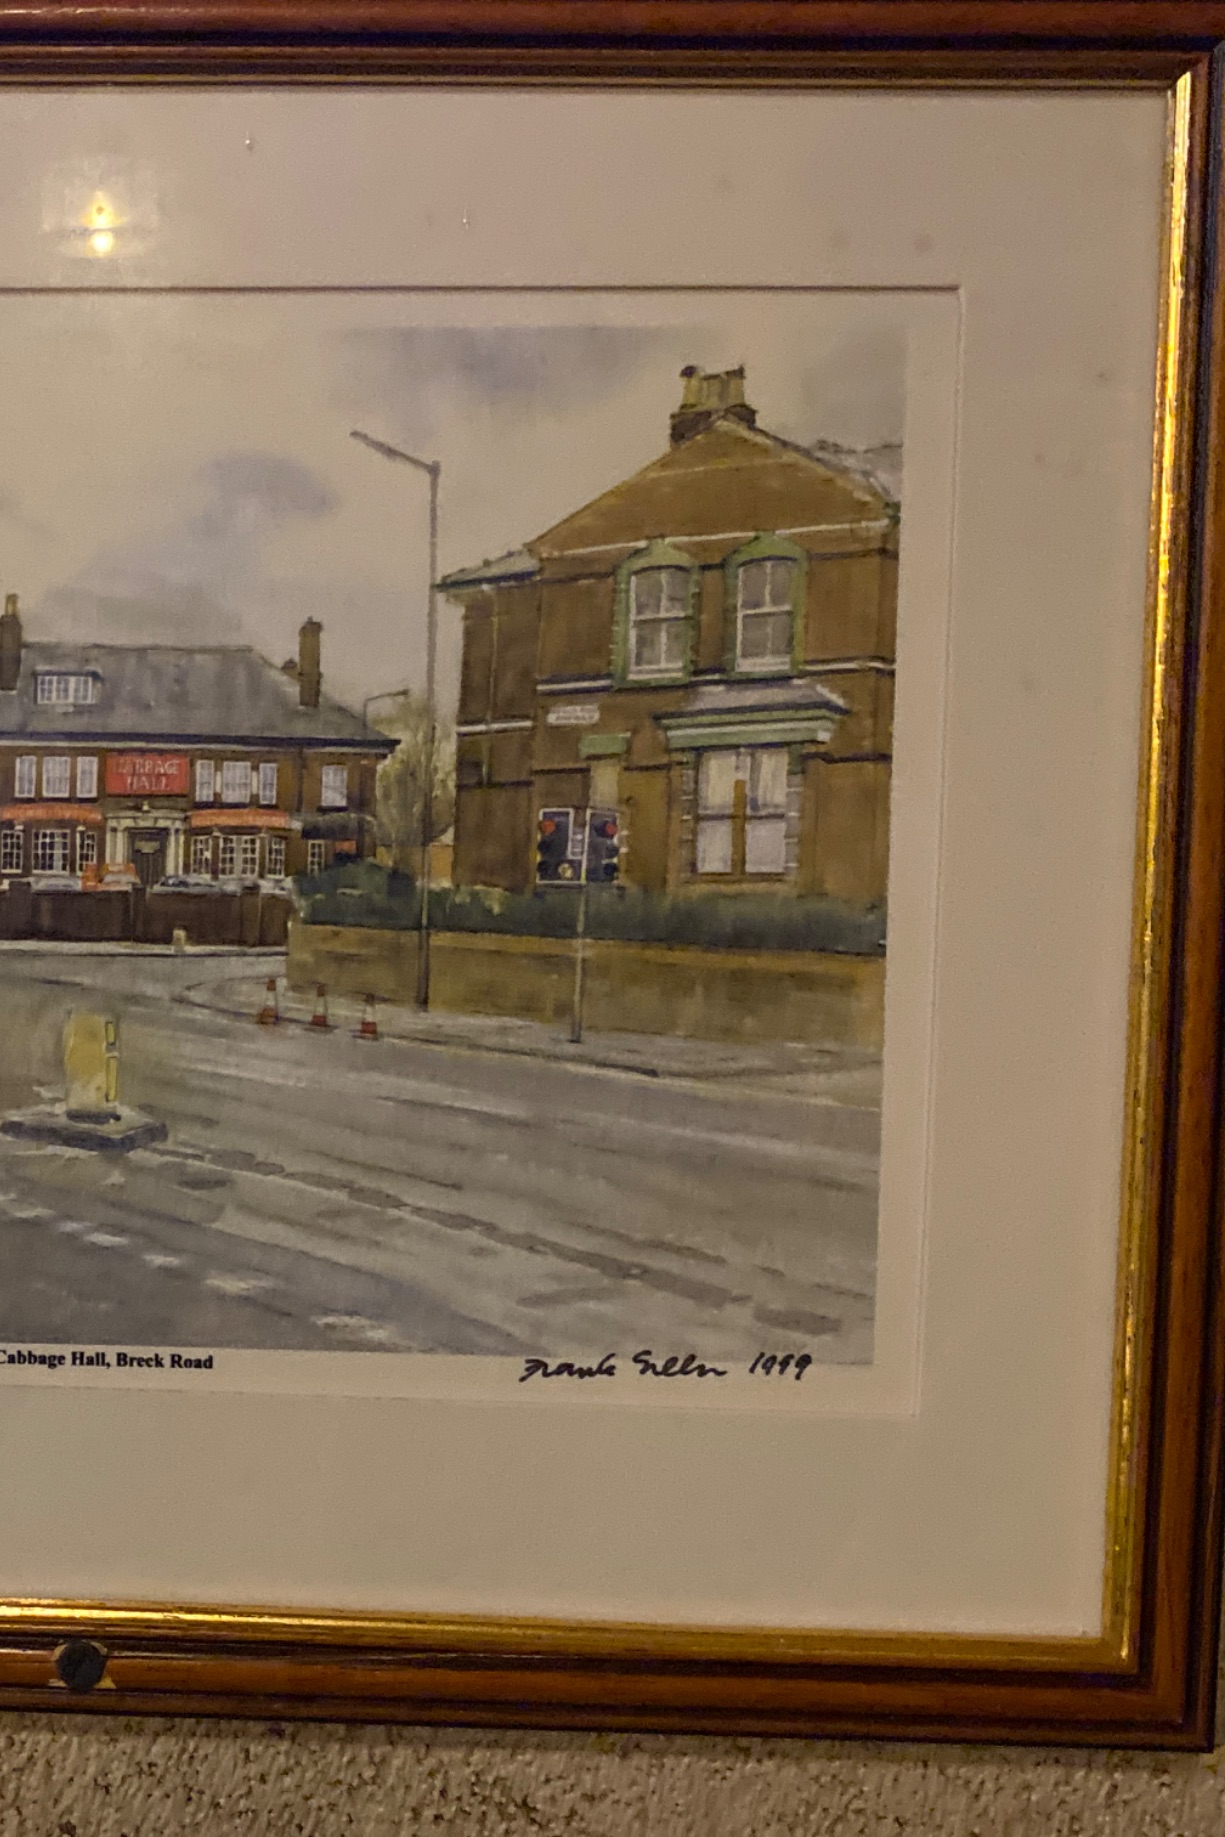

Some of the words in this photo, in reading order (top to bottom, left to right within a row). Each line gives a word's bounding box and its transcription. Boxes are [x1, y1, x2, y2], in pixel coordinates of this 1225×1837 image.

[70, 1351, 111, 1369] Hall,
[116, 1352, 165, 1368] Breck
[169, 1353, 214, 1370] Road
[748, 1352, 813, 1381] 1999
